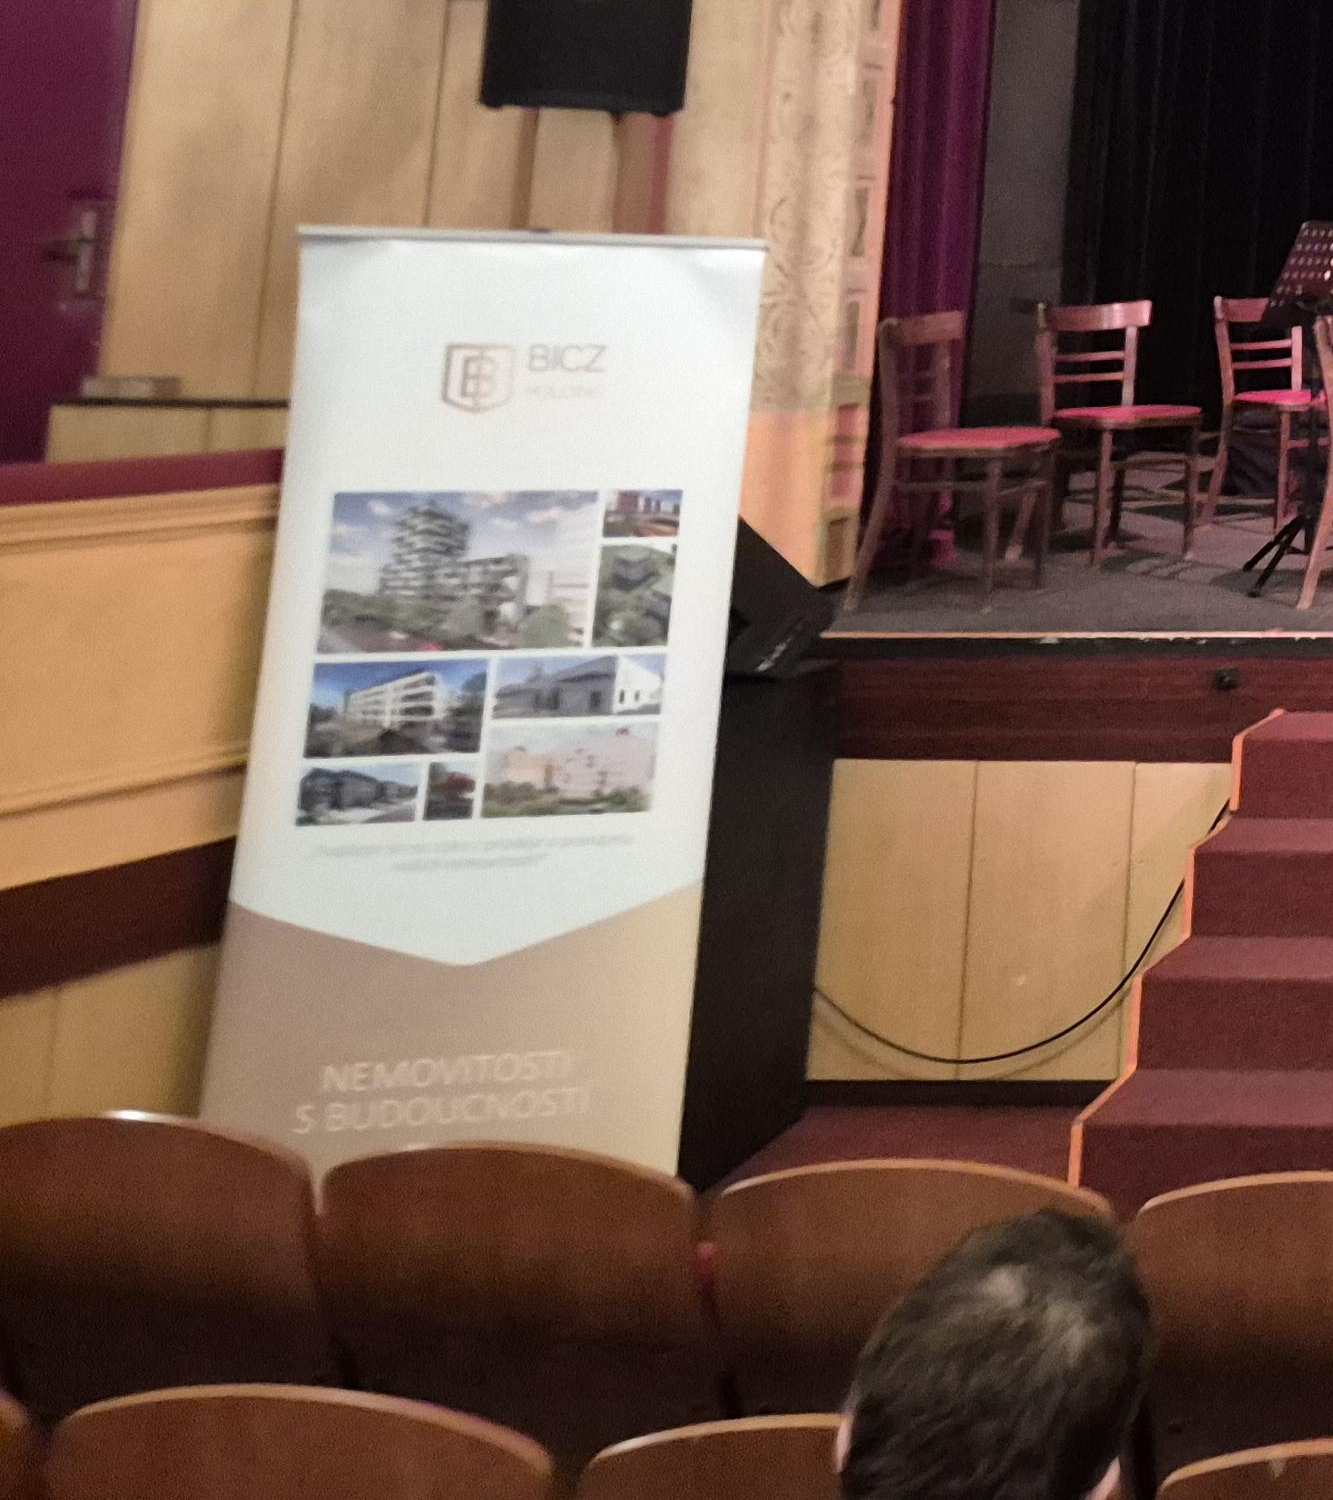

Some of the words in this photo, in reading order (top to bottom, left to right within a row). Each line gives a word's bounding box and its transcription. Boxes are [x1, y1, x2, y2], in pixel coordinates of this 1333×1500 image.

[528, 343, 607, 372] BICZ
[320, 1050, 573, 1093] NEMOVITOSTI
[292, 1103, 317, 1135] S
[324, 1086, 591, 1133] BUDOUCNOSTI
